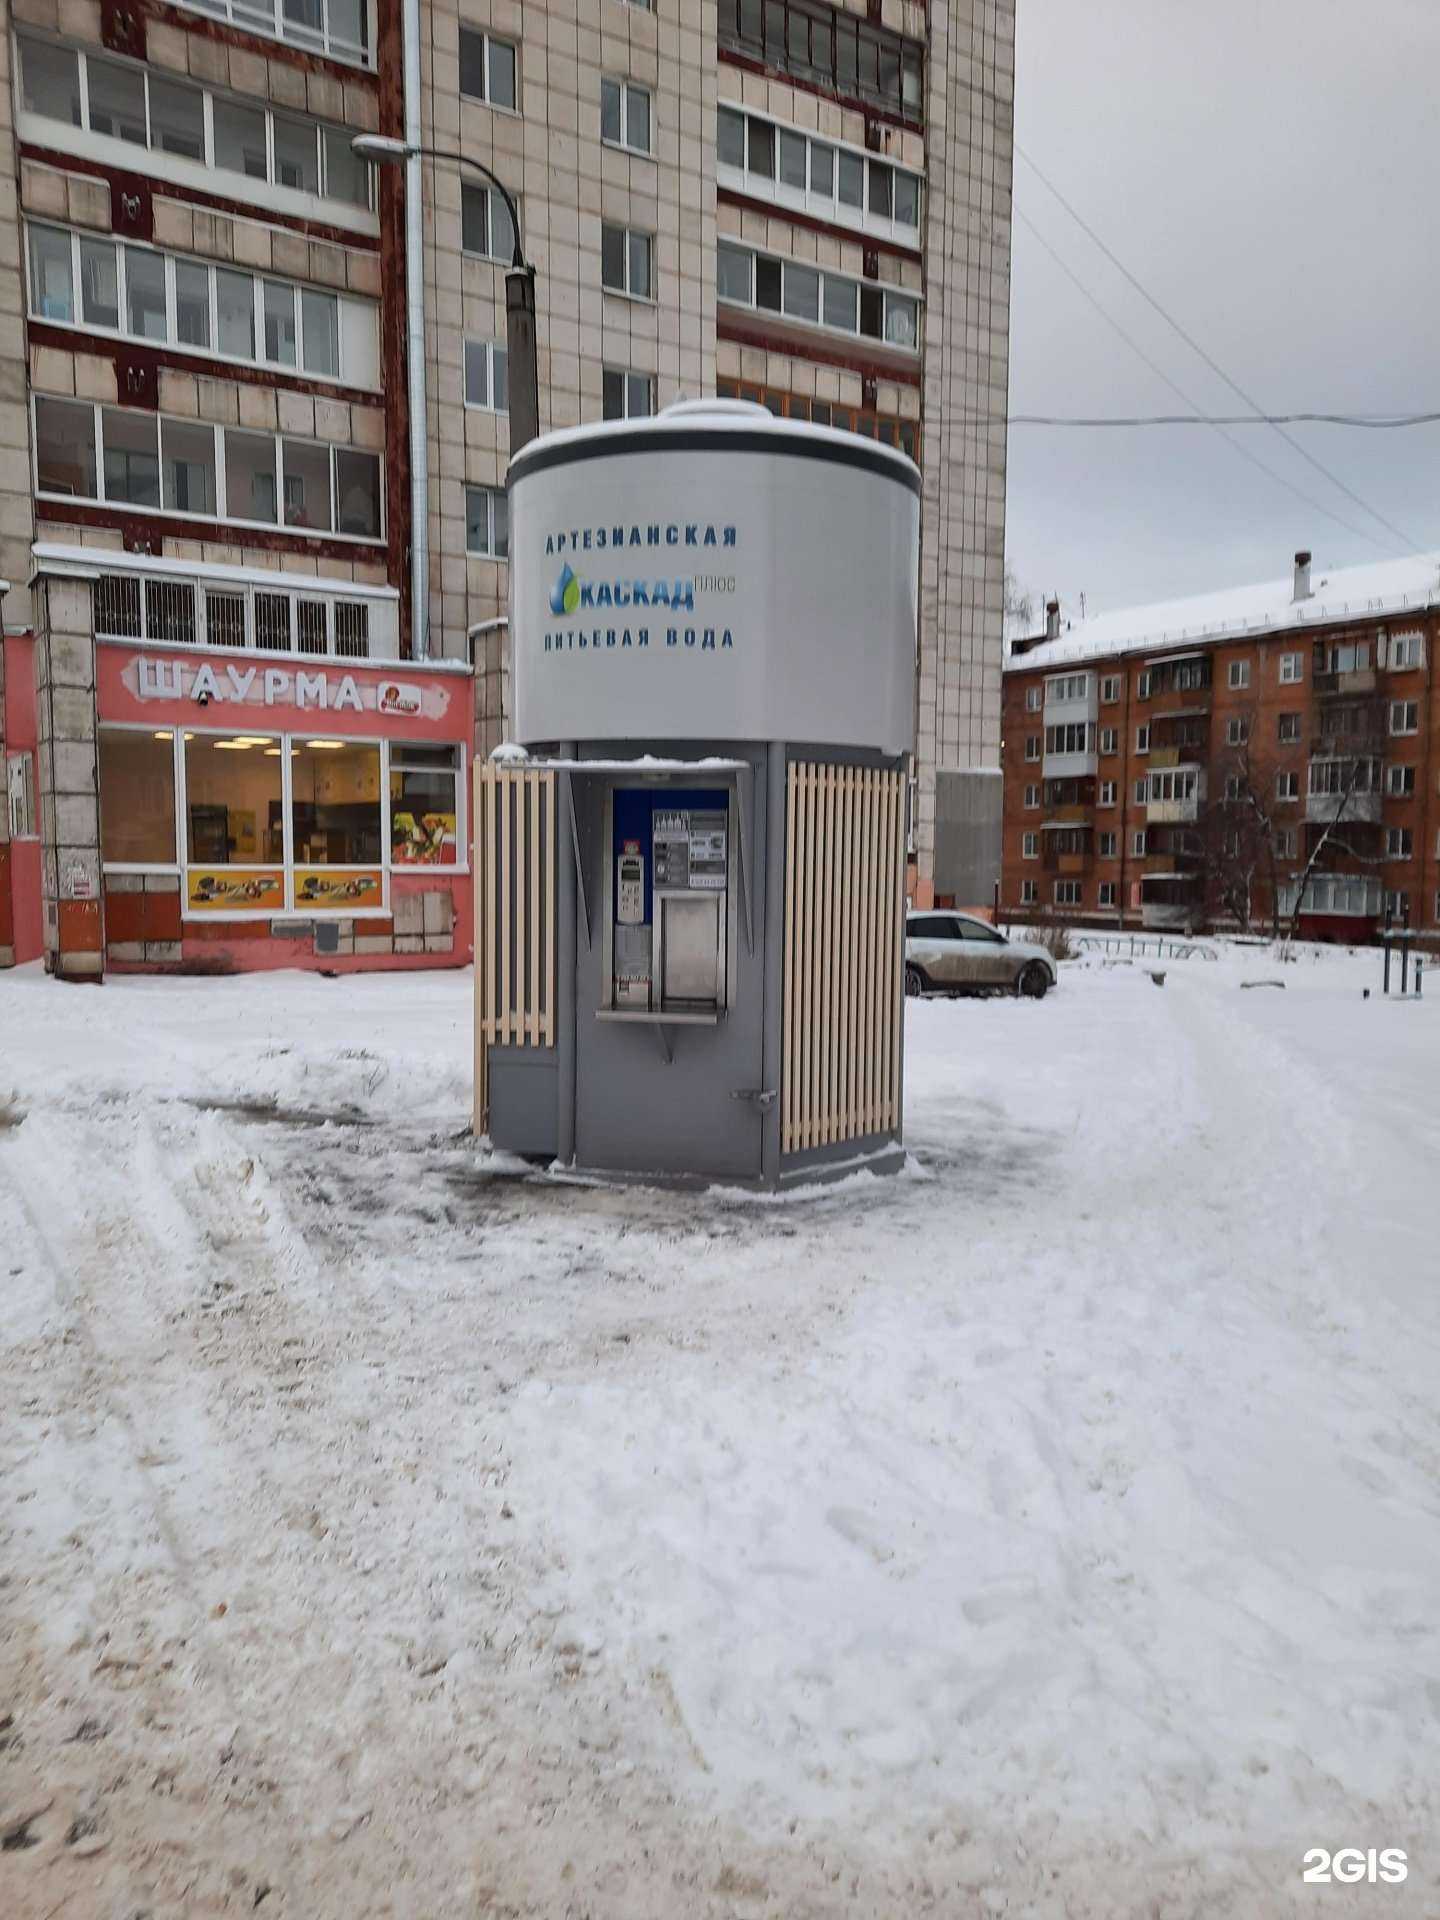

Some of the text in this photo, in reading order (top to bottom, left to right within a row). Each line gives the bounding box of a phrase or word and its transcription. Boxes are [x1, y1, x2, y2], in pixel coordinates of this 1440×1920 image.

[545, 525, 737, 554] АРТЕЗИАНСКАЯ
[580, 578, 694, 612] КАСКАД
[544, 628, 734, 652] ПИТЬЕВАЯ ВОДА
[137, 656, 364, 712] ШАУРМА
